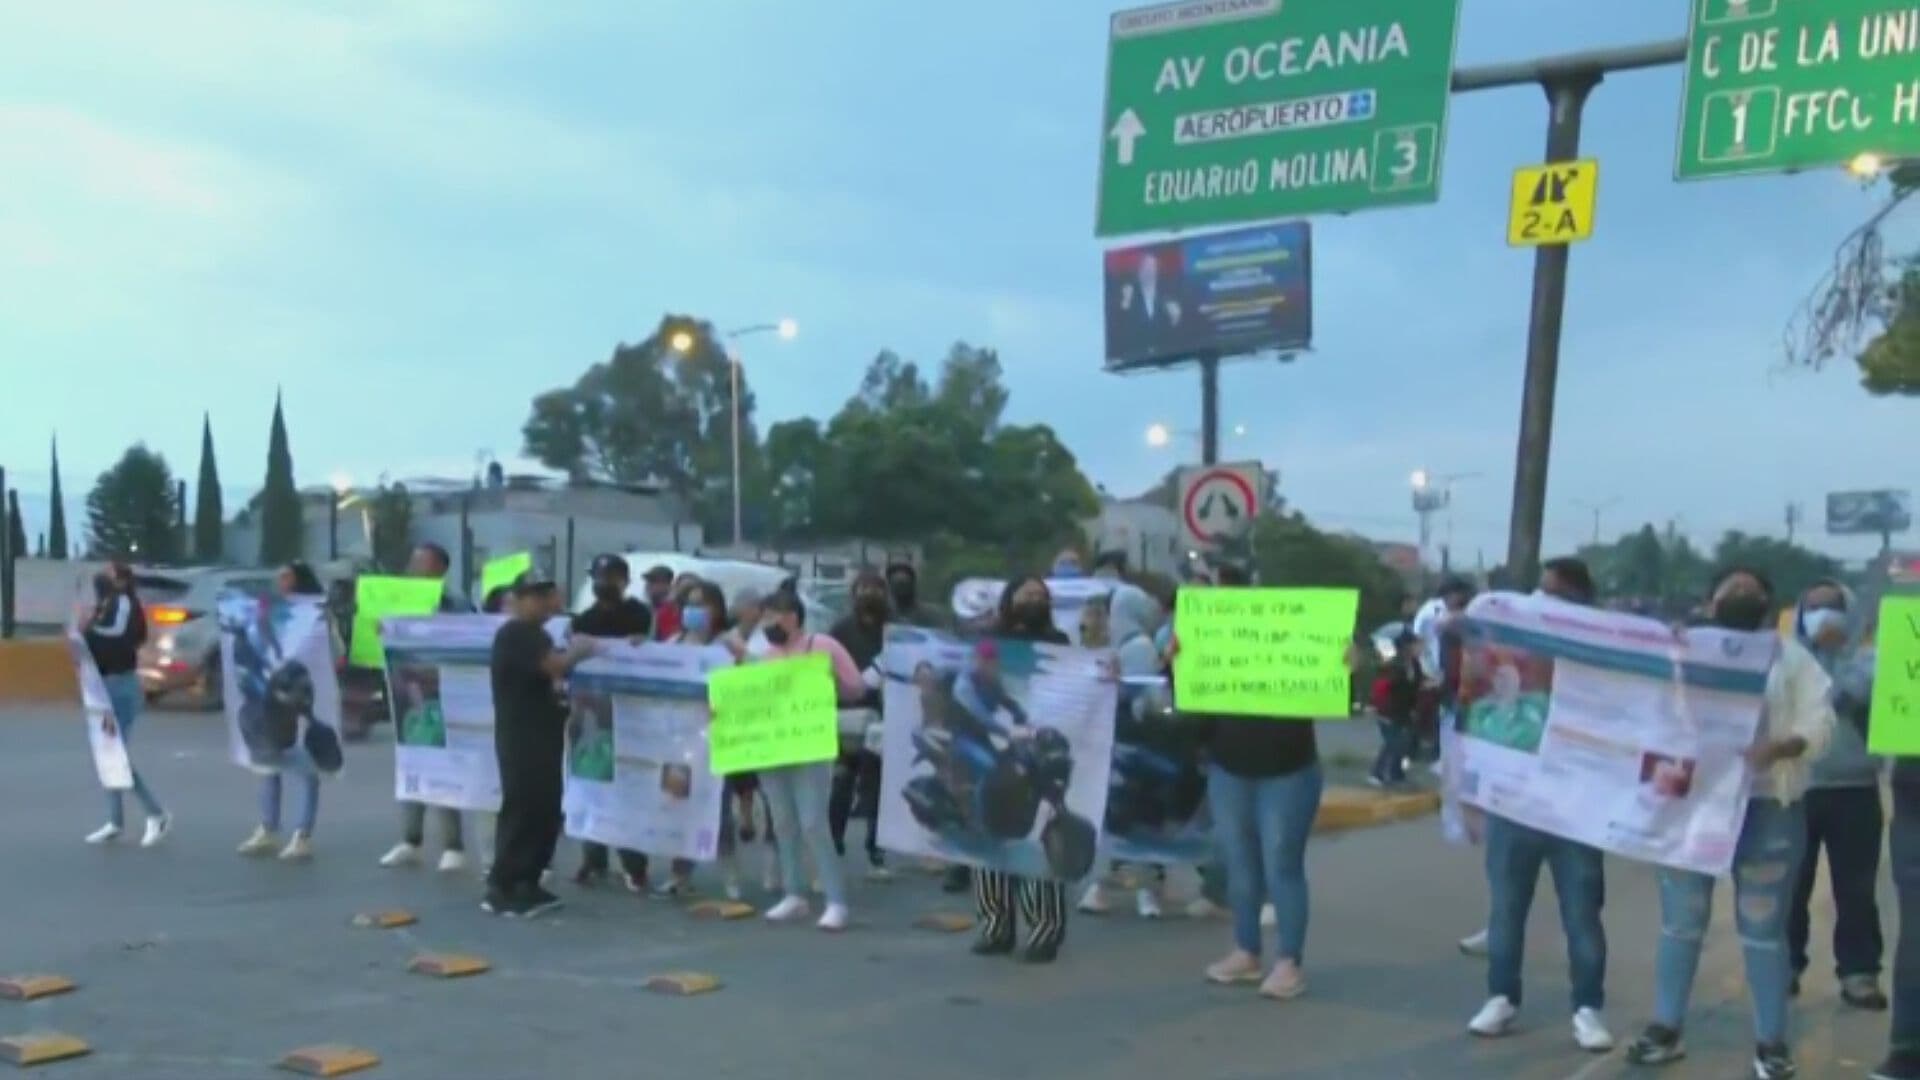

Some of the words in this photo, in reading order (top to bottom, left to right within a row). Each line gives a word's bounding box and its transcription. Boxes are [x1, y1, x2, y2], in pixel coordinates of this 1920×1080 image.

[1154, 56, 1205, 94] AV
[1224, 22, 1410, 85] OCEANIA
[1702, 36, 1721, 78] C
[1738, 27, 1779, 74] DE
[1796, 21, 1840, 66] LA
[1178, 97, 1342, 139] AEROPUERTO
[1731, 104, 1748, 144] 1
[1270, 147, 1367, 191] MOLINA
[1388, 140, 1418, 175] 3
[1520, 208, 1577, 239] 2-A
